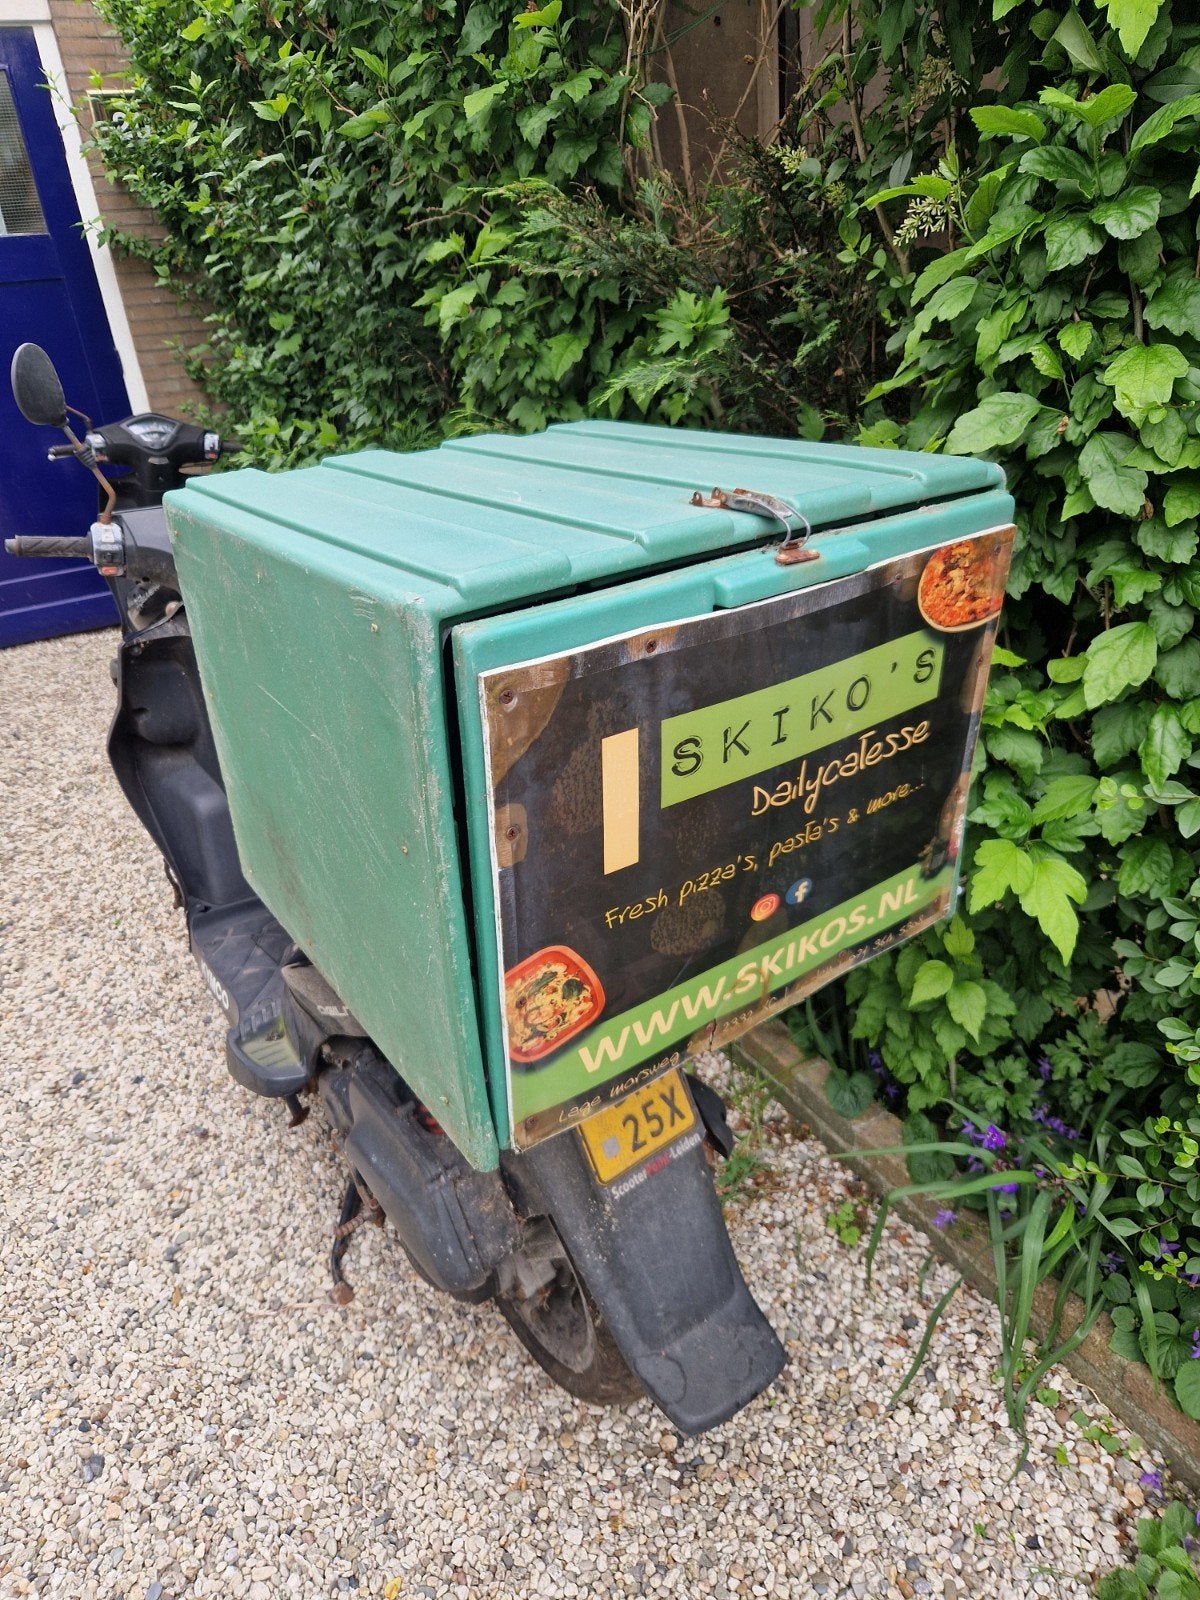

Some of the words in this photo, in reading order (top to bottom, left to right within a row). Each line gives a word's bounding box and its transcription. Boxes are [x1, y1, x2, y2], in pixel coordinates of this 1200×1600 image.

[671, 647, 935, 777] SKIKO'S
[751, 720, 931, 816] Dailycatesse
[604, 887, 668, 929] Fresh
[679, 854, 759, 907] pizza's,
[768, 817, 840, 868] pasta's
[846, 808, 860, 824] &
[578, 877, 919, 1073] WWW.SKIKOS.NL
[621, 1086, 686, 1153] 25X
